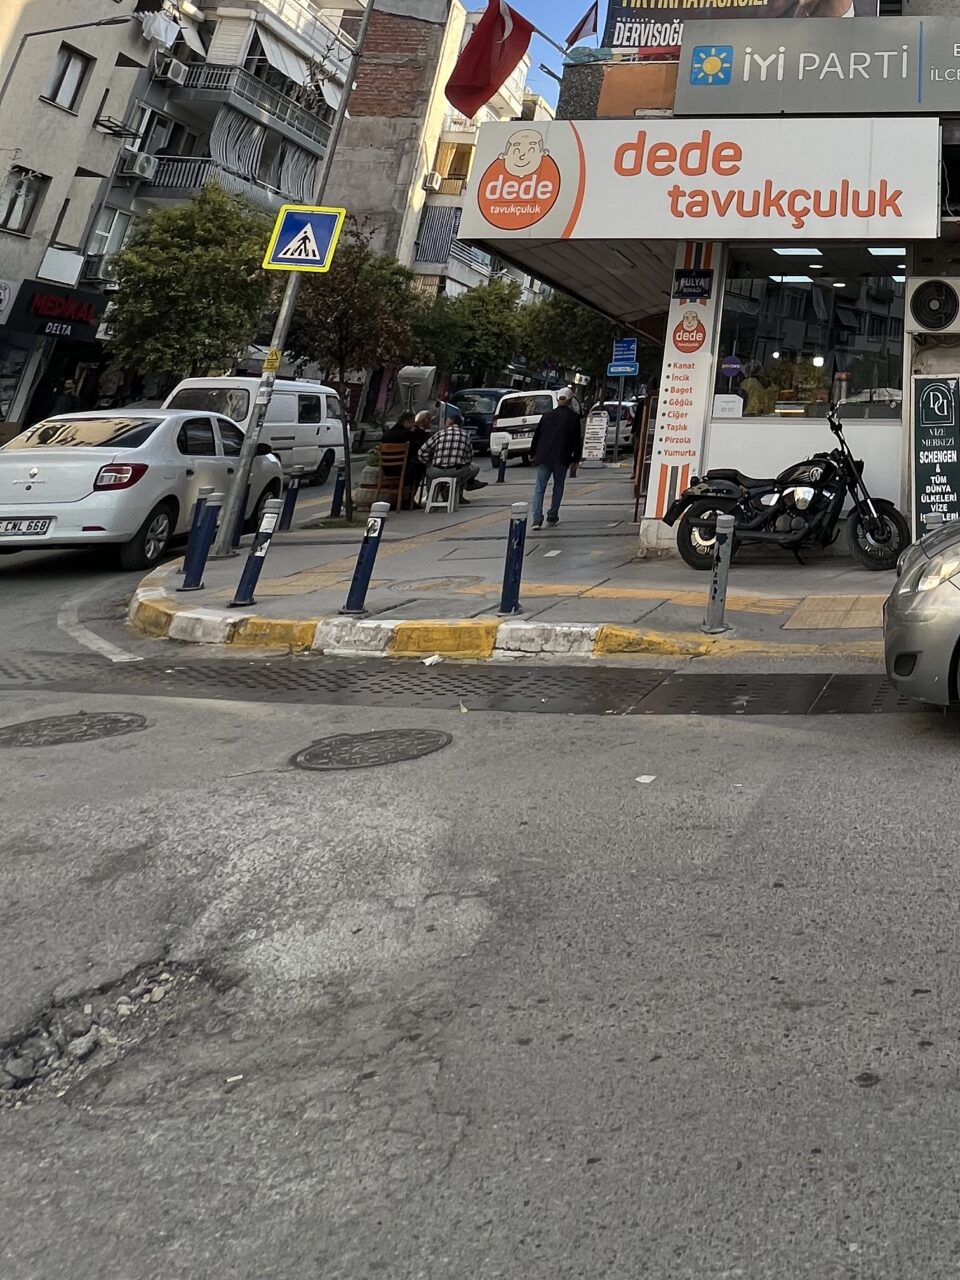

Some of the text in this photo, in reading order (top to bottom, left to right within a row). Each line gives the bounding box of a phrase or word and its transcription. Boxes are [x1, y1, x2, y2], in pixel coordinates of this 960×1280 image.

[742, 44, 909, 81] İYİ PARTİ
[613, 129, 743, 177] dede
[485, 176, 553, 200] dede
[667, 178, 903, 229] tavukçuluk
[489, 202, 541, 216] tavukçuluk
[45, 321, 72, 336] DELTA
[676, 330, 703, 341] dede
[673, 362, 695, 370] Kanat
[671, 373, 690, 382] İncik
[670, 386, 693, 394] Baget
[668, 399, 693, 407] Göğüs
[667, 410, 688, 419] Ciğer
[666, 423, 688, 432] Taşlık
[664, 436, 691, 444] Pirzola
[663, 449, 696, 457] Yumurta
[919, 450, 957, 464] SCHENGEN
[935, 464, 941, 473] &
[930, 474, 947, 484] TÜM
[925, 483, 951, 493] DÜNYA
[920, 493, 957, 503] ÜLKELERİ
[930, 503, 948, 512] VİZE
[4, 520, 47, 532] CNL 668
